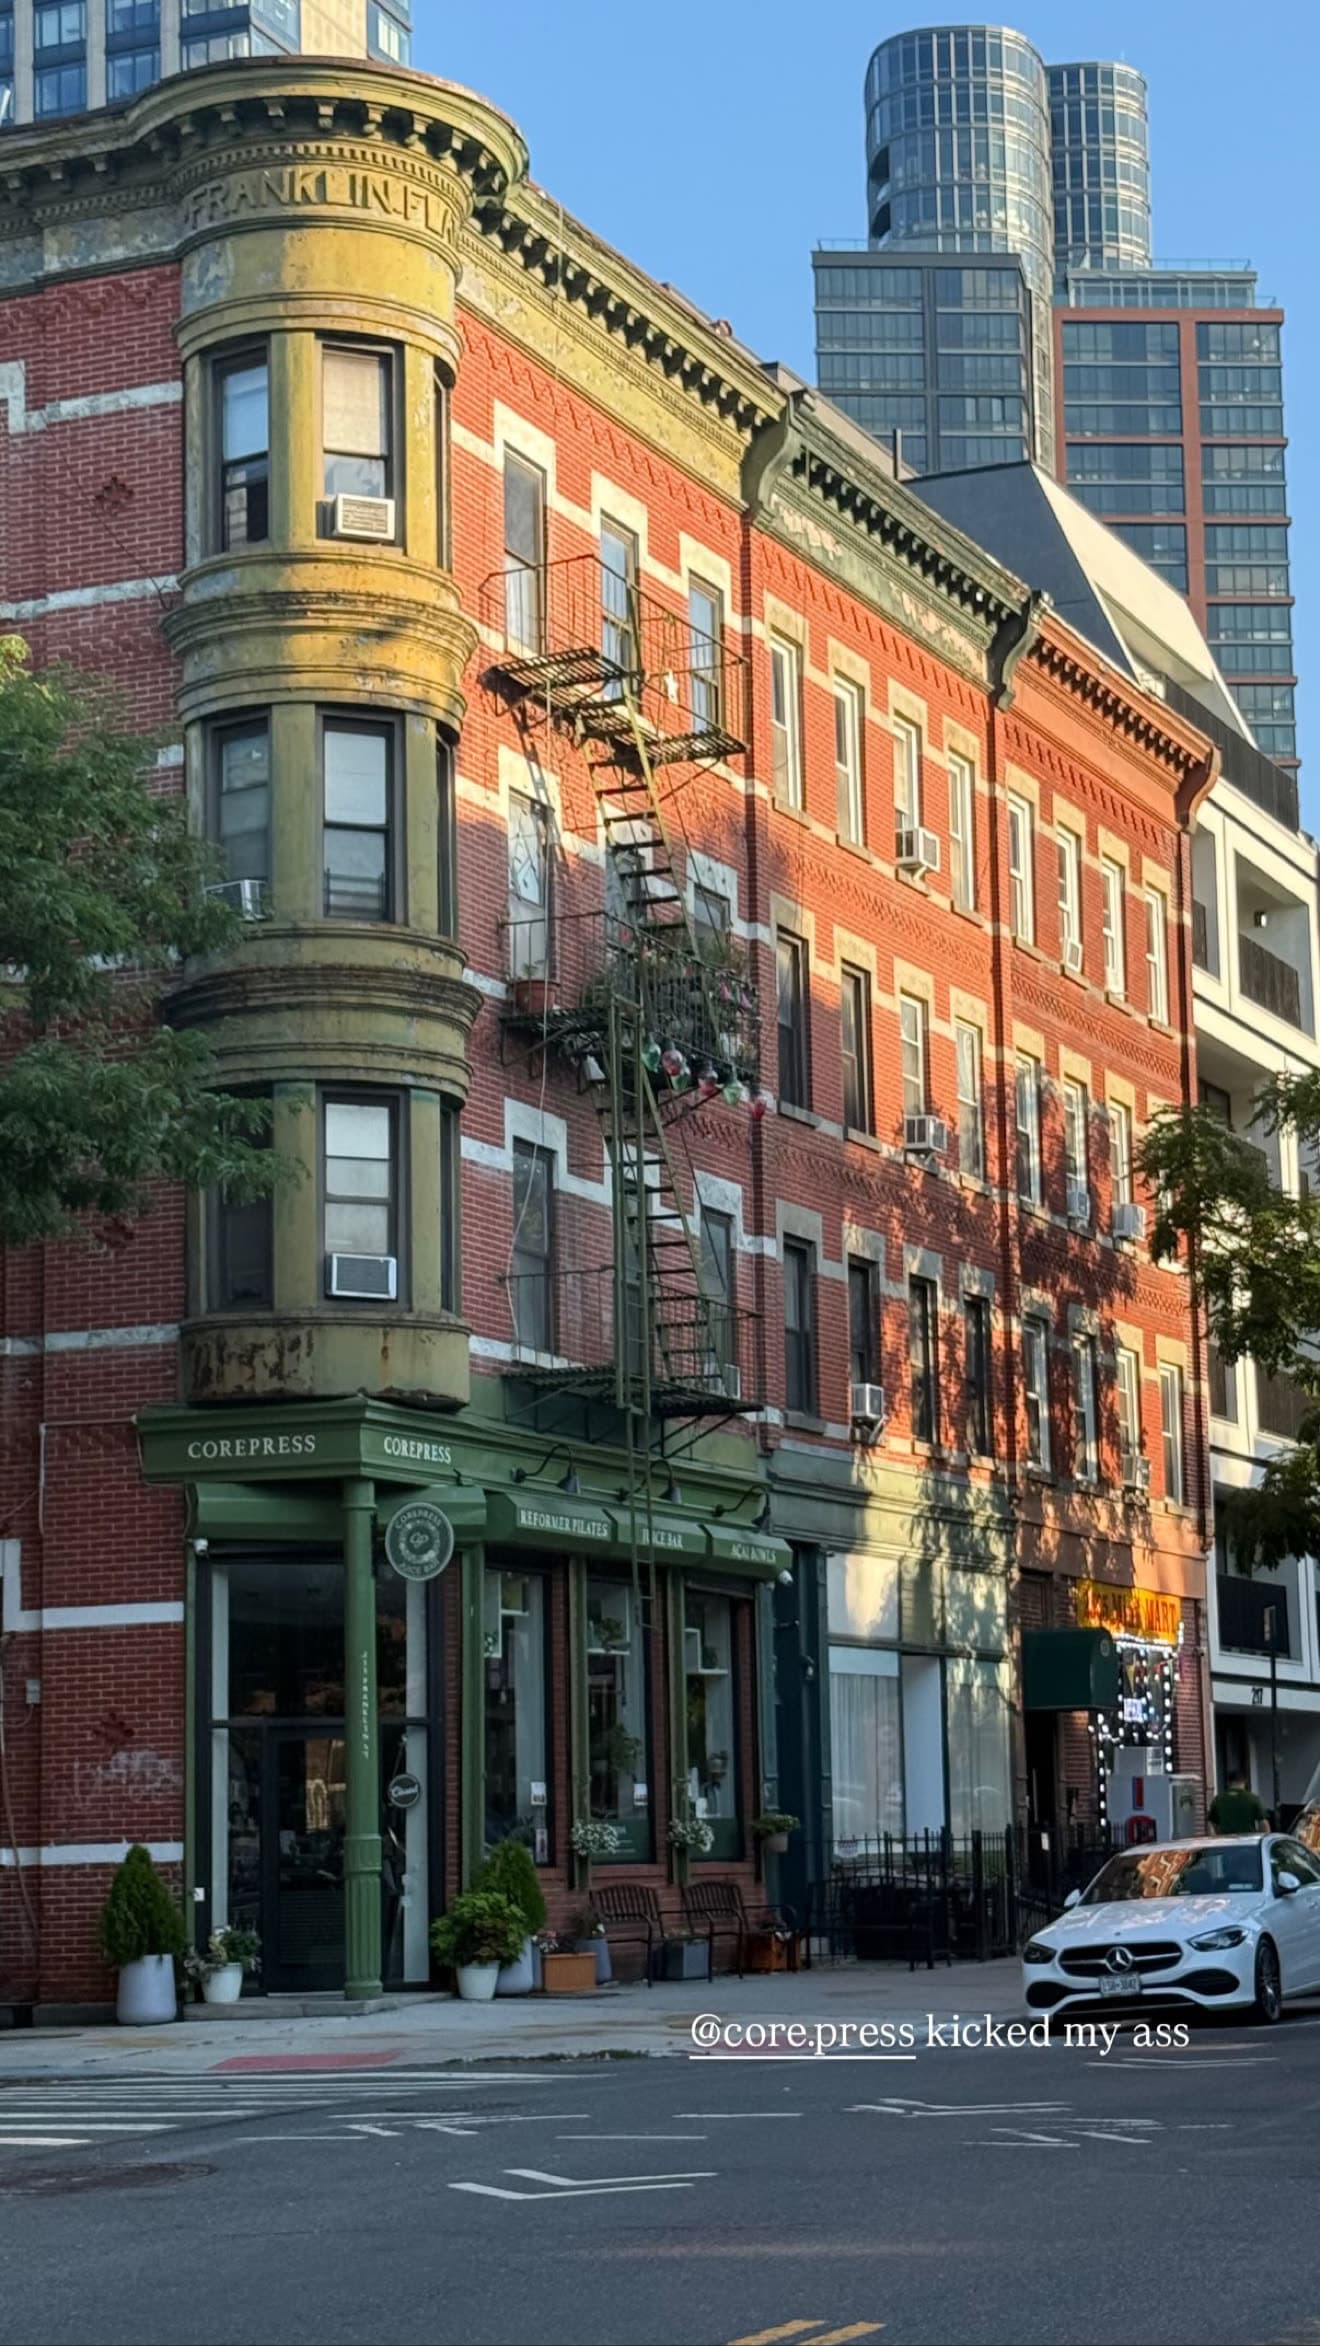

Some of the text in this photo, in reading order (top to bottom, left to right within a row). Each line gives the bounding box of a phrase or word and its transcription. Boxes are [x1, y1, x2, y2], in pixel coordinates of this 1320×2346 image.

[188, 1434, 316, 1459] COREPRESS
[383, 1436, 451, 1464] COREPRESS
[519, 1509, 609, 1538] REFORMER PILATES
[667, 1532, 683, 1550] BAR
[1146, 1598, 1177, 1633] MART
